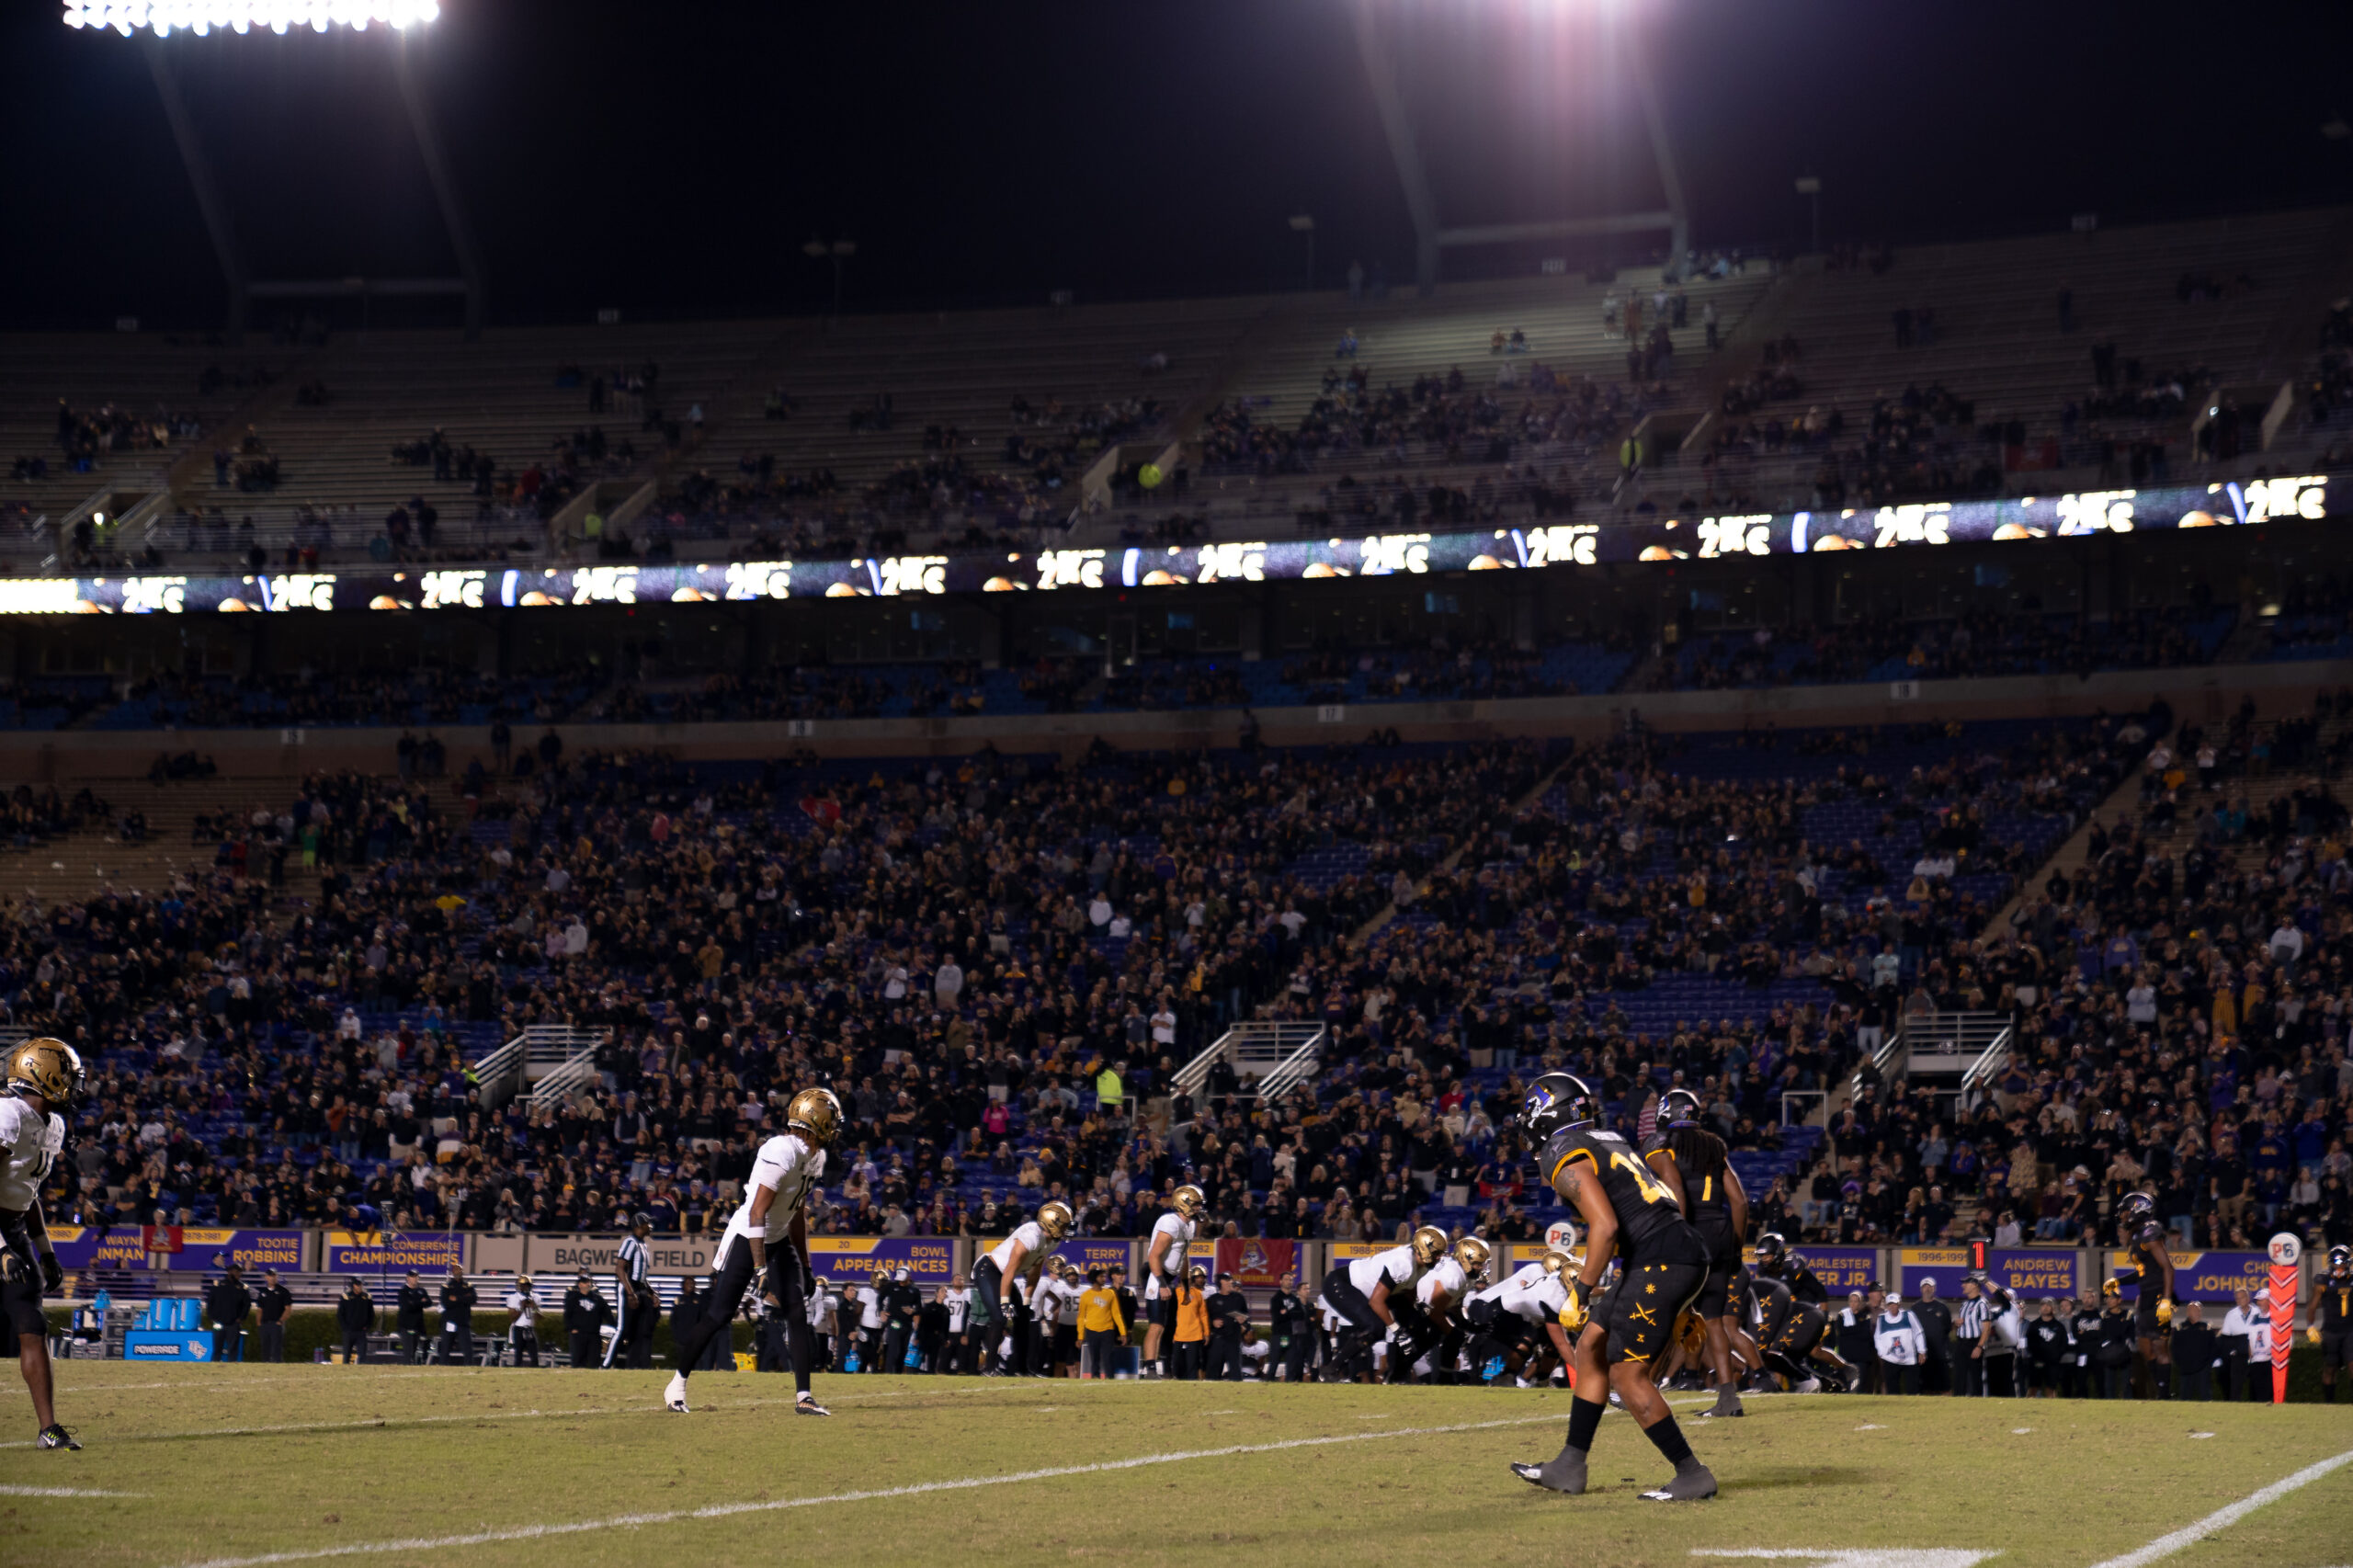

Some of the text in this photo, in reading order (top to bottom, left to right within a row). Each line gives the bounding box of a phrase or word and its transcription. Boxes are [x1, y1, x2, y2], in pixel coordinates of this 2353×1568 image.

[256, 1238, 299, 1249] TOOTIE
[838, 1241, 850, 1249] 20
[1549, 1230, 1572, 1246] P6
[392, 1241, 460, 1251] CONFERENCE
[911, 1246, 949, 1257] BOWL
[2271, 1243, 2294, 1259] P6
[97, 1247, 144, 1261] INMAN
[233, 1250, 298, 1264] ROBBINS
[339, 1251, 459, 1266] CHAMPIONSHIPS
[654, 1250, 705, 1267] FIELD
[1085, 1248, 1125, 1260] TERRY
[1972, 1242, 1984, 1268] 1
[833, 1258, 949, 1273] APPEARANCES
[2003, 1258, 2072, 1271] ANDREW
[1843, 1272, 1870, 1286] JR.
[2010, 1273, 2072, 1290] BAYES
[948, 1301, 963, 1315] 57
[1064, 1296, 1079, 1312] 85
[133, 1345, 180, 1355] POWERADE
